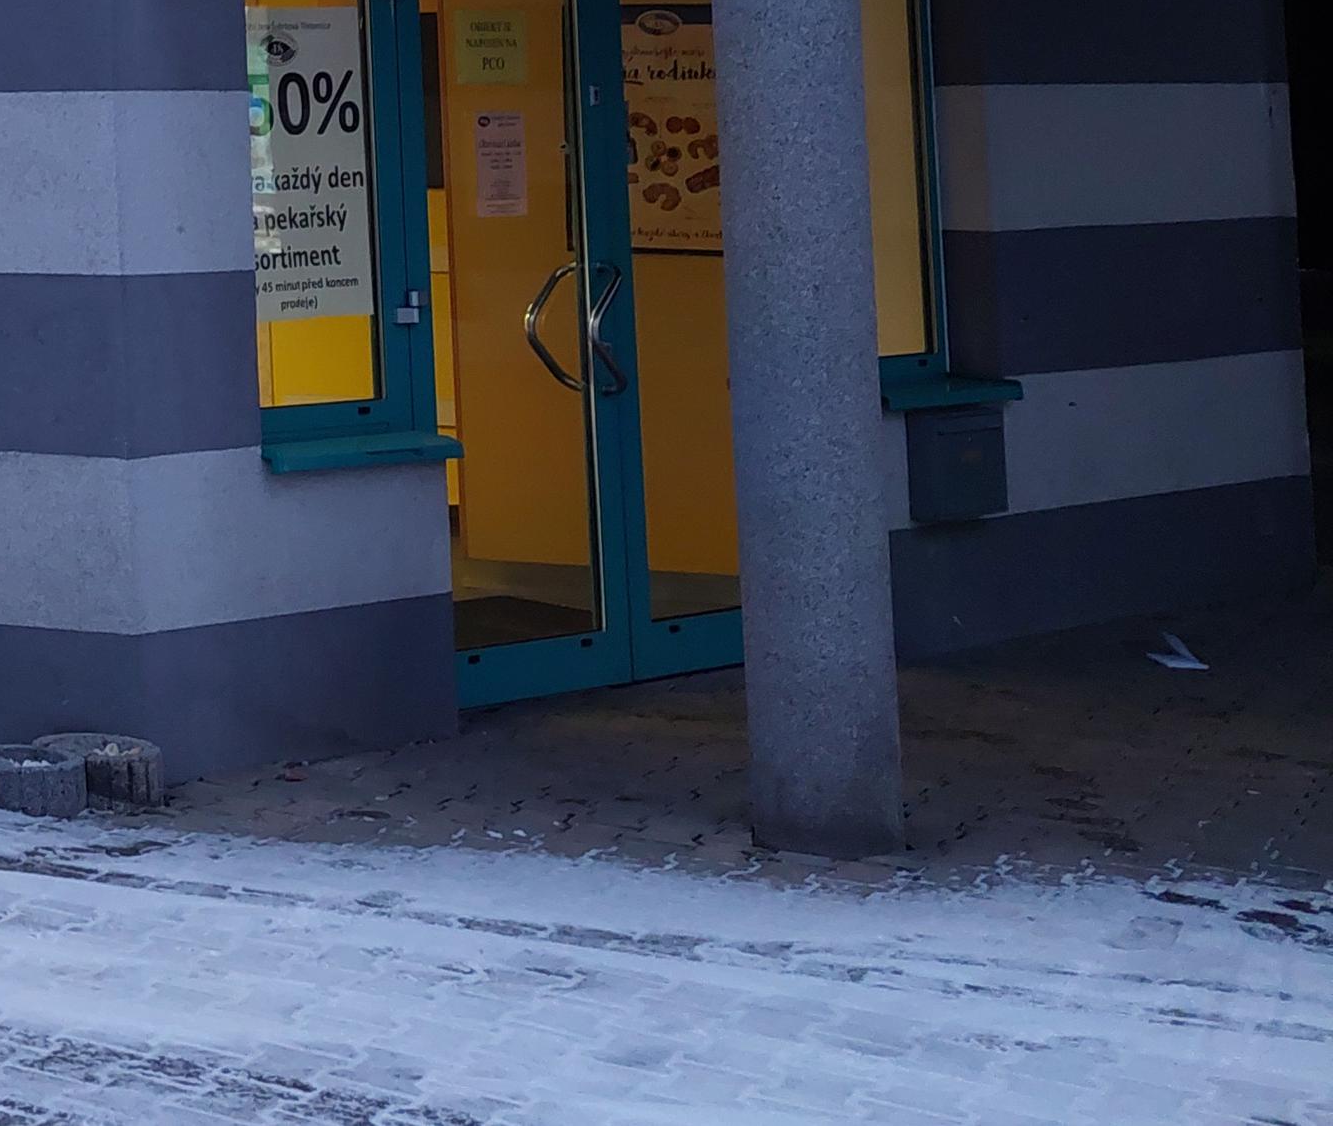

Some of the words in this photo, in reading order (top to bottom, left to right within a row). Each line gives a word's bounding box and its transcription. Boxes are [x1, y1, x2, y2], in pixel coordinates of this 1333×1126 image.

[329, 165, 364, 189] den
[265, 202, 347, 236] pekařský
[275, 279, 301, 292] minut
